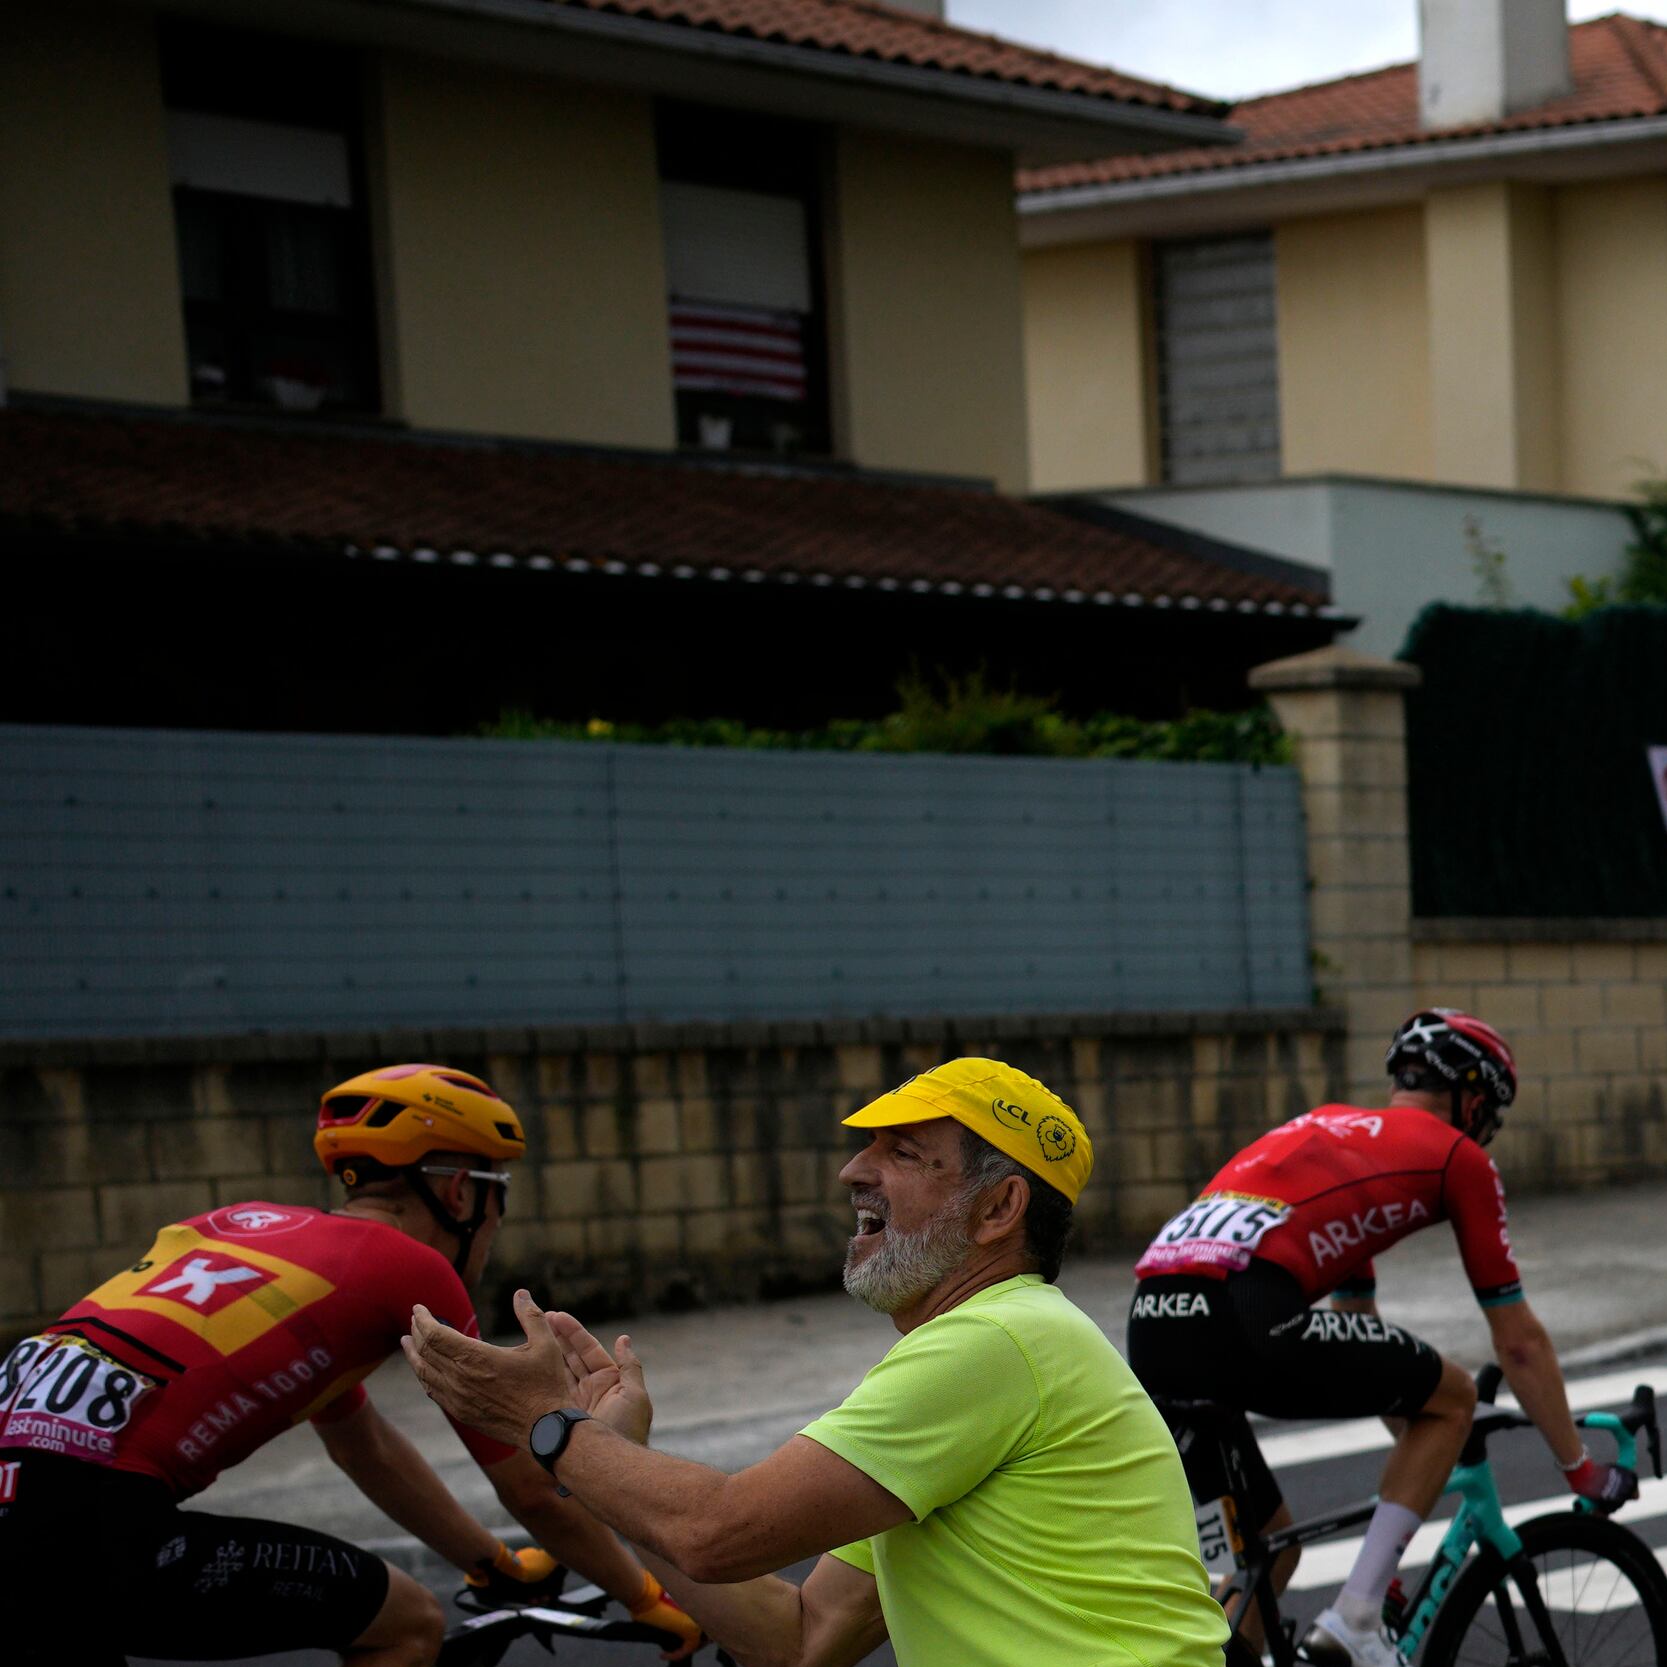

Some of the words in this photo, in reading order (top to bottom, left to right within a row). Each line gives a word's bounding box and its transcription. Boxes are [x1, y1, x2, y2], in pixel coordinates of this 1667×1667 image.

[996, 1098, 1032, 1127] LCL
[1308, 1197, 1431, 1269] ARKEA
[1131, 1292, 1211, 1319] ARKEA
[175, 1391, 262, 1463] REMA
[252, 1345, 333, 1401] 1000
[251, 1541, 360, 1581] REITAN
